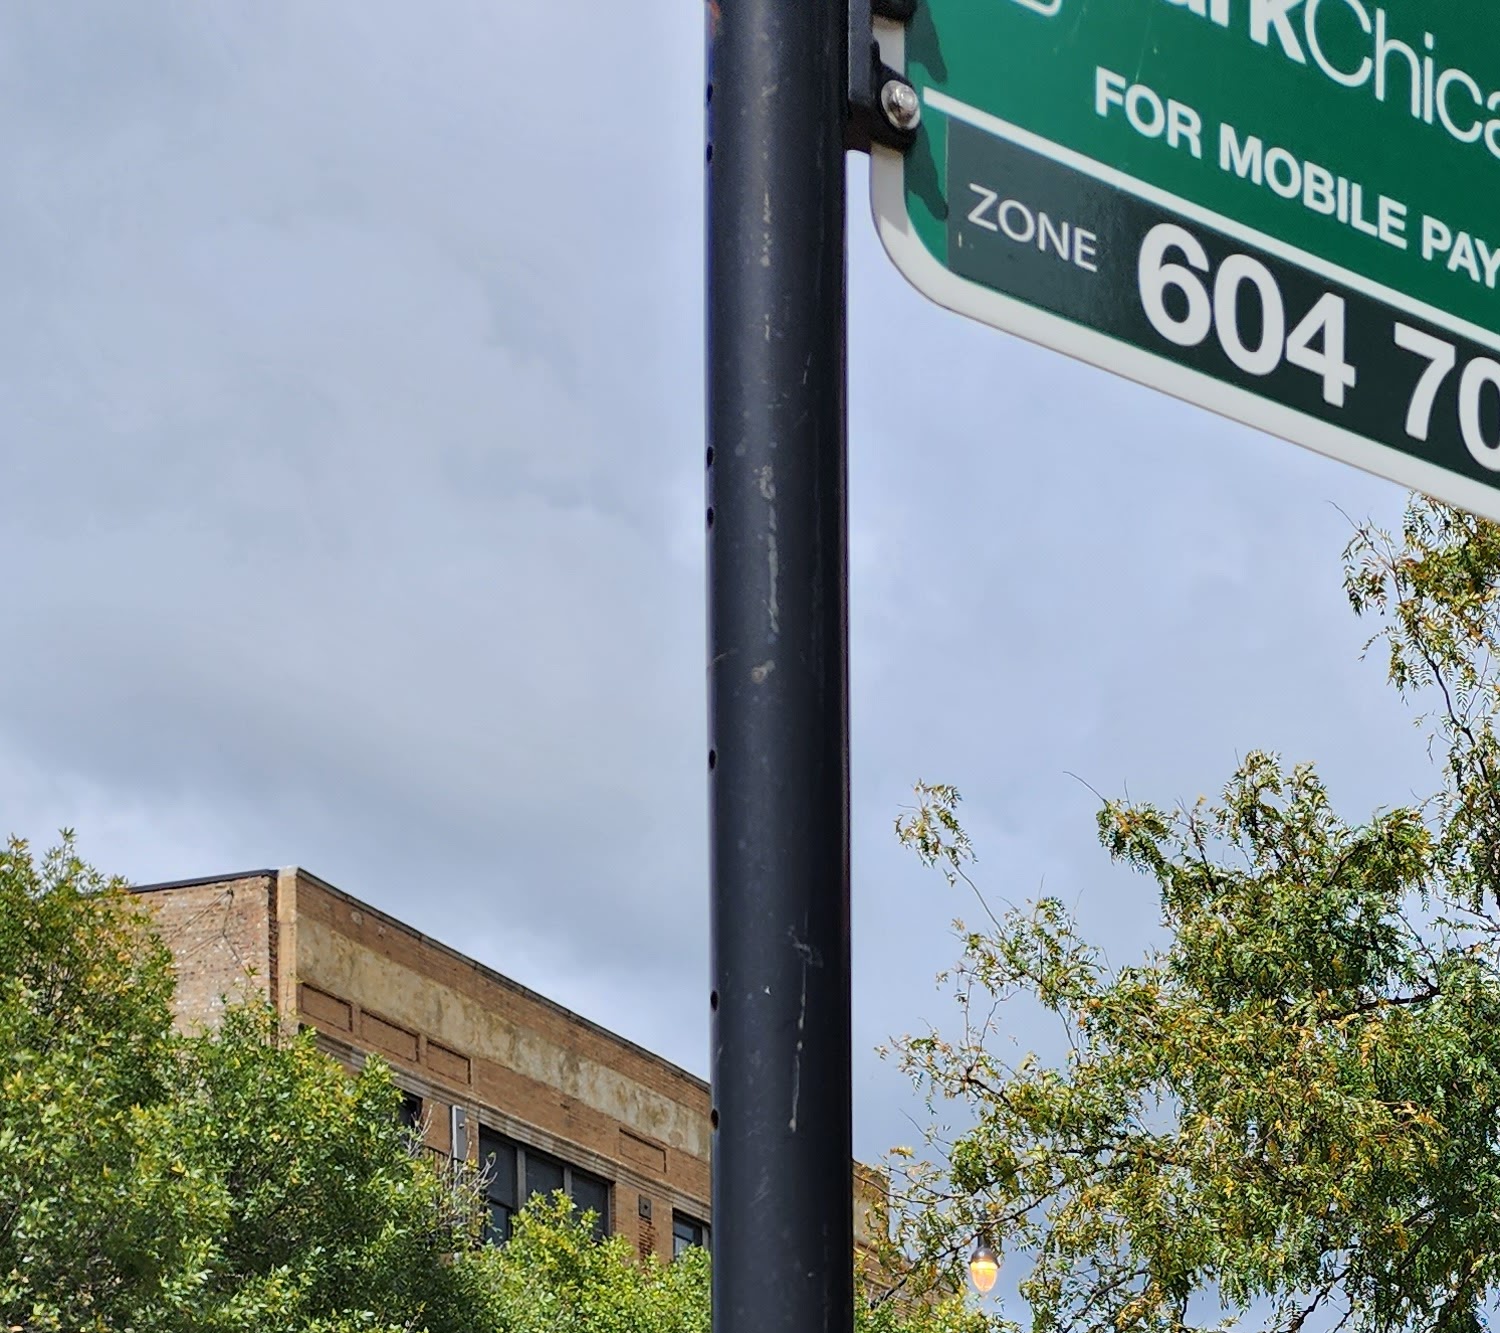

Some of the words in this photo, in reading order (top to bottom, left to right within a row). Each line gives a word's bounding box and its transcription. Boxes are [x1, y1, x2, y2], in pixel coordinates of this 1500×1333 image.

[968, 182, 1098, 273] ZONE
[1095, 66, 1202, 159] FOR
[1219, 124, 1407, 249] MOBILE
[1138, 223, 1357, 408] 604
